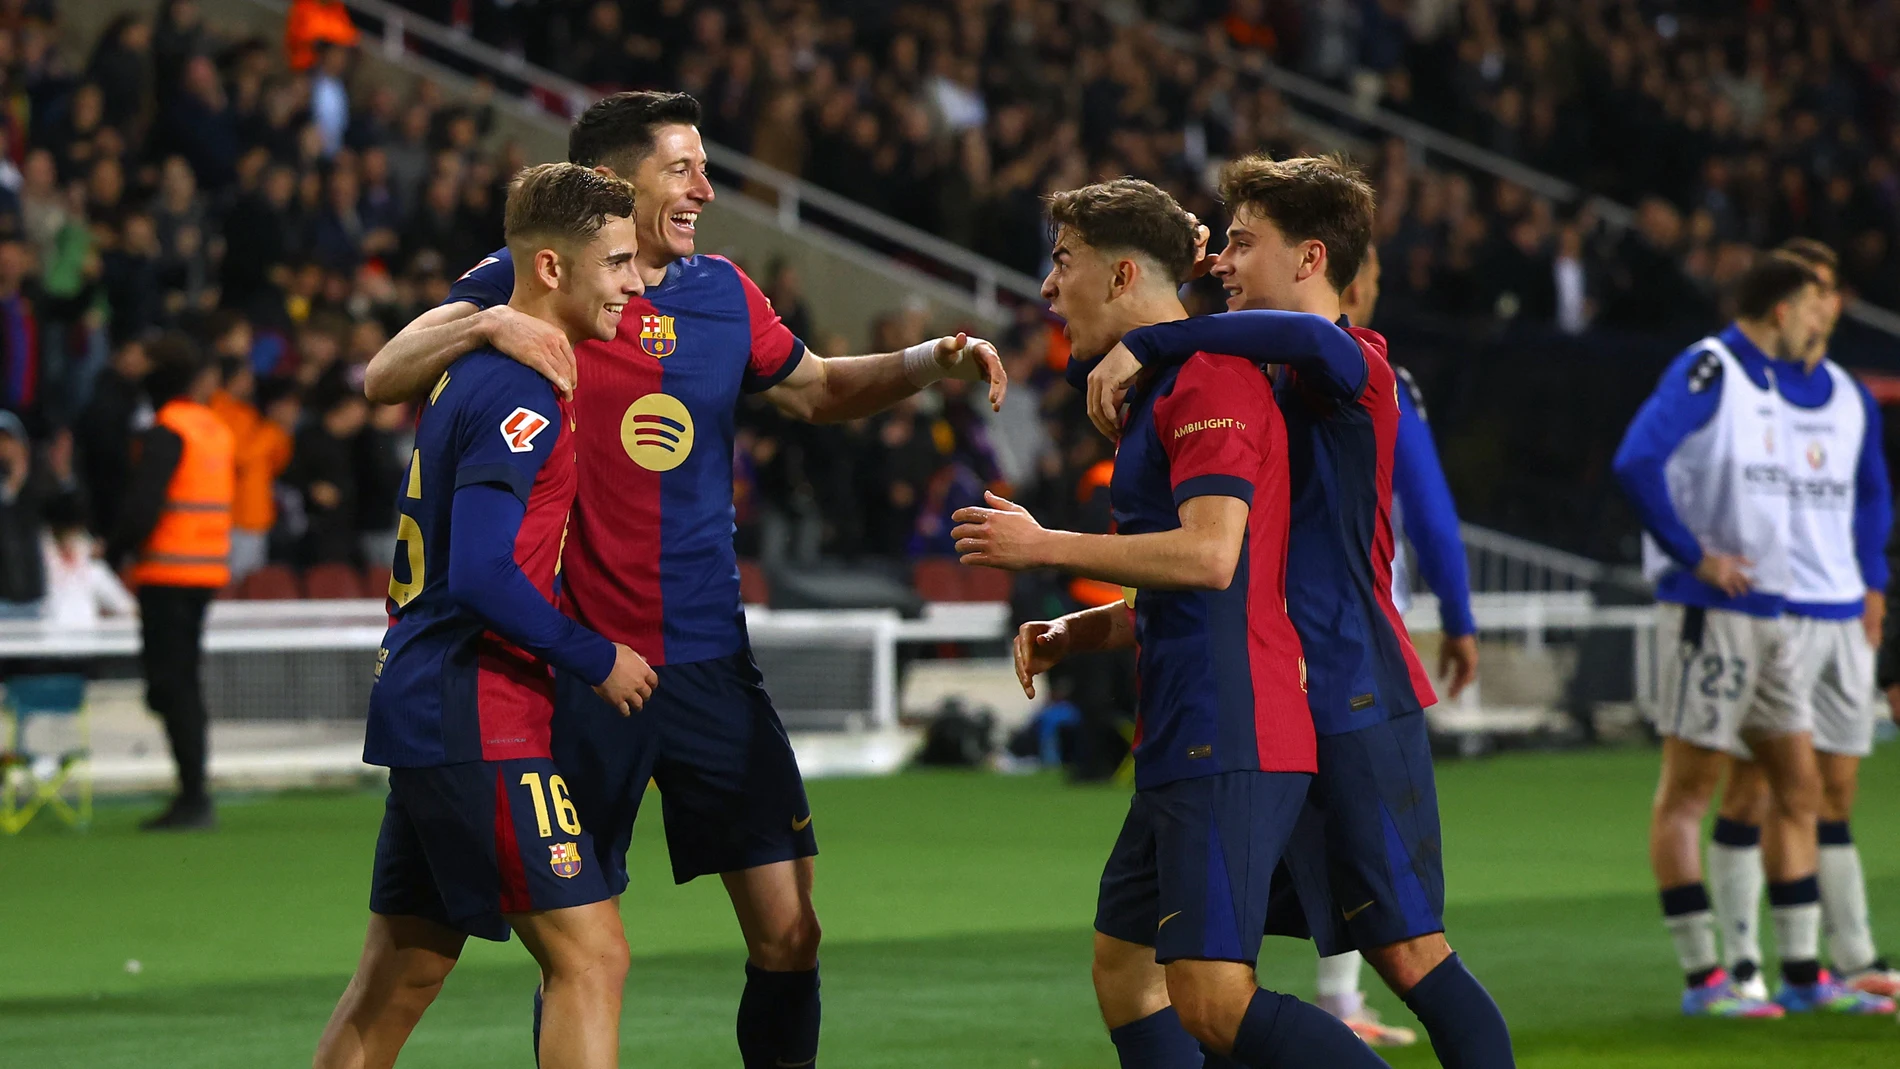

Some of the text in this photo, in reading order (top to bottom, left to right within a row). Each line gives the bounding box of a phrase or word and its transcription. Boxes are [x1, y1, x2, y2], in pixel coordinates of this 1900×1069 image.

[1174, 418, 1246, 440] AMBILIGHT tv
[1701, 655, 1747, 701] 23
[520, 772, 582, 838] 16
